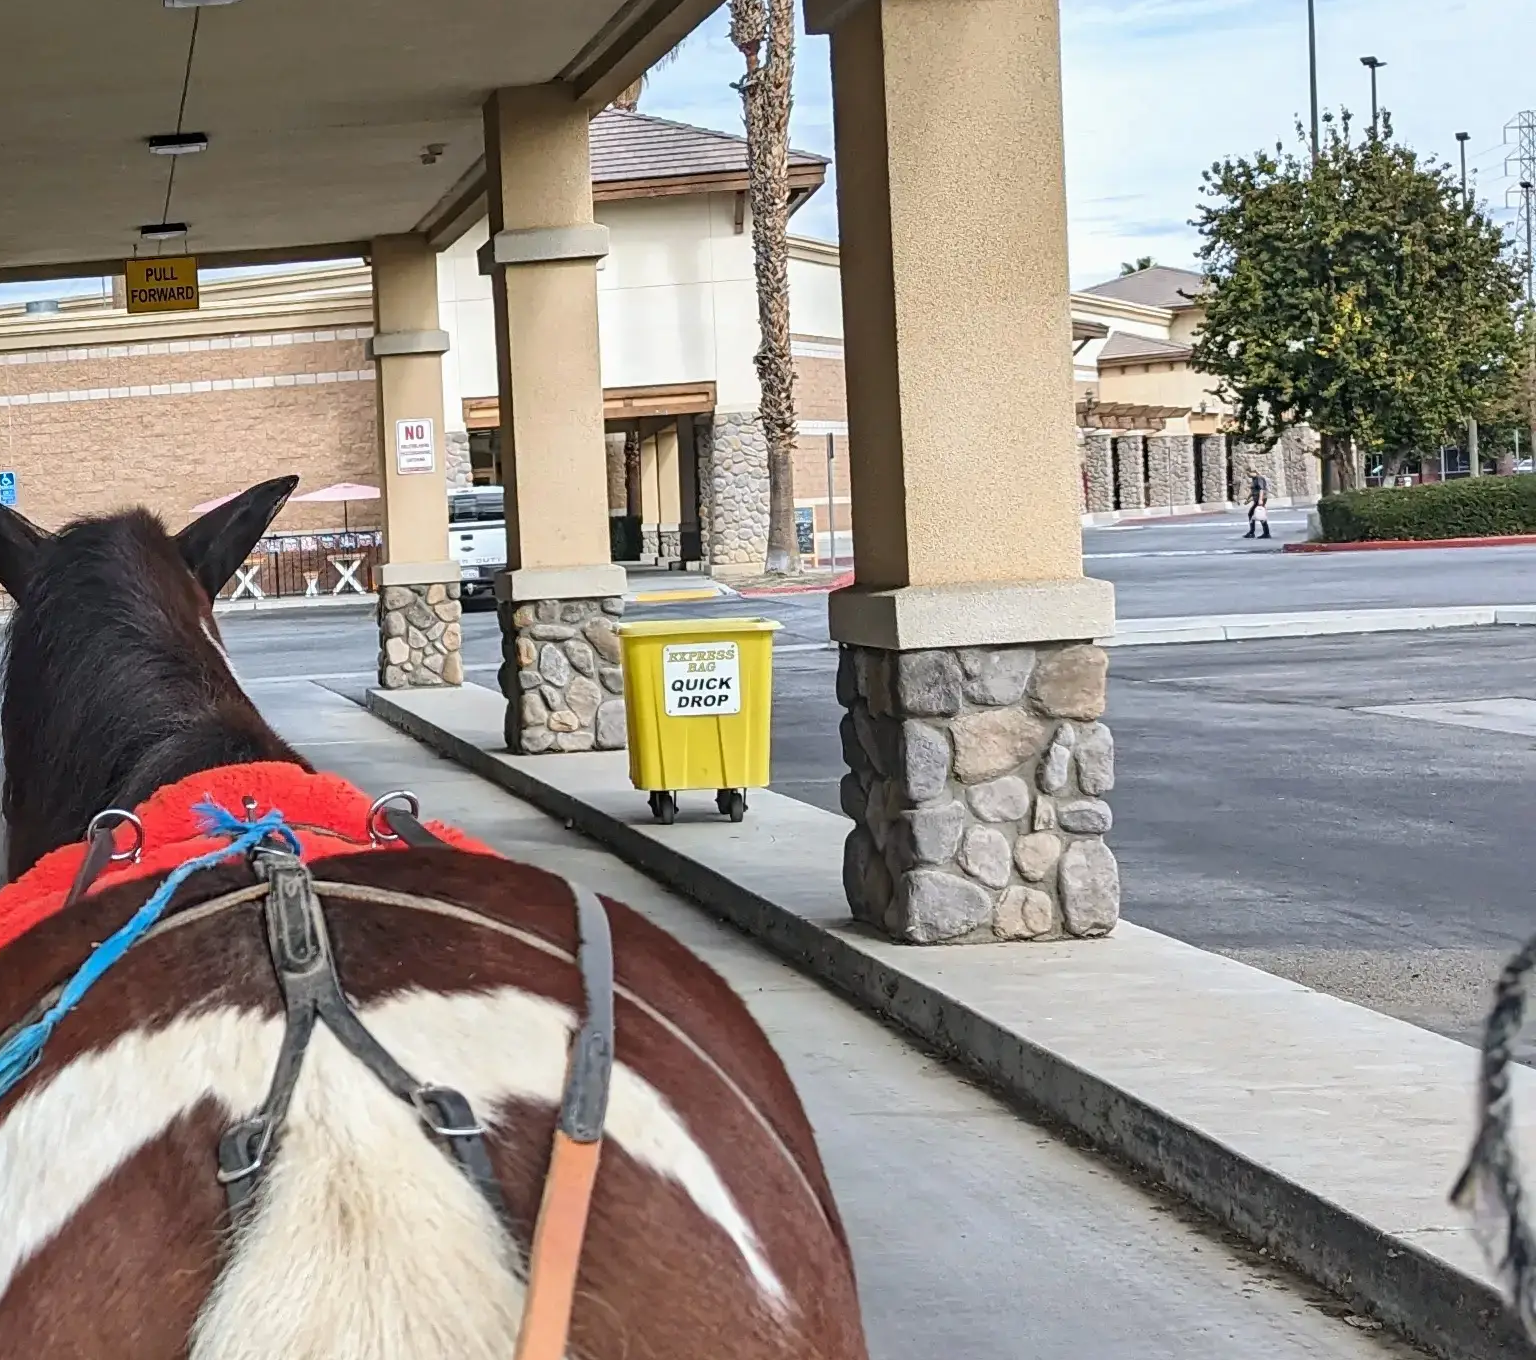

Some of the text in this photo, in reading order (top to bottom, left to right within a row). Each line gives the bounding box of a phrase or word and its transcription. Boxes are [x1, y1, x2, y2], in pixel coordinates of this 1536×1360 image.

[145, 266, 178, 282] PULL
[131, 285, 194, 303] FORWARD
[404, 425, 424, 441] NO
[667, 649, 735, 662] EXPRESS
[687, 661, 716, 673] BAG
[671, 677, 732, 692] QUICK
[677, 694, 729, 708] DROP
